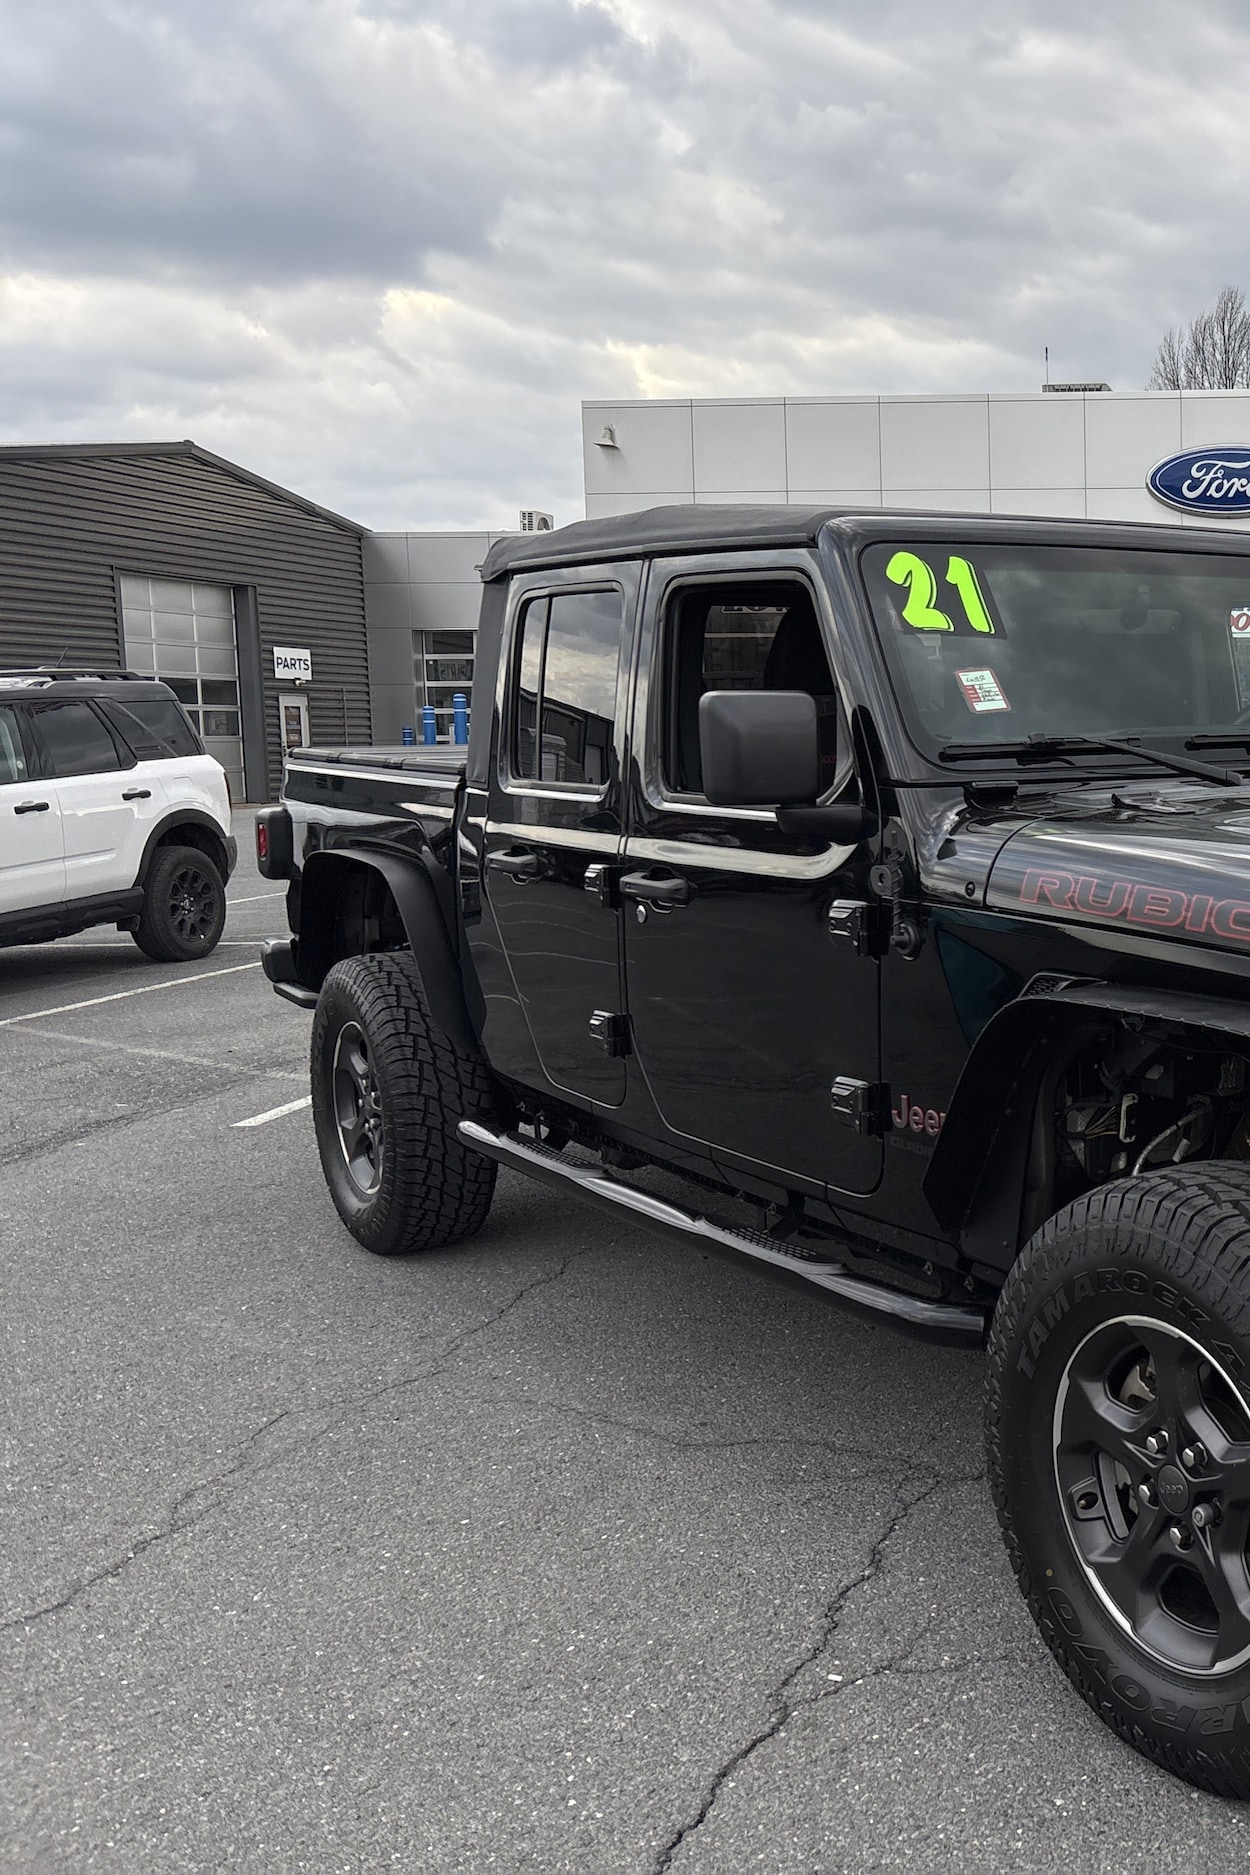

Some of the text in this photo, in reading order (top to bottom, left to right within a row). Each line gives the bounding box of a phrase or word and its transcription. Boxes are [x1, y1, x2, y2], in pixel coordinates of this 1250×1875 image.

[886, 551, 996, 634] 21
[276, 657, 310, 671] PARTS
[1016, 1268, 1211, 1380] TAMAROCK
[1160, 1481, 1184, 1495] Jeep
